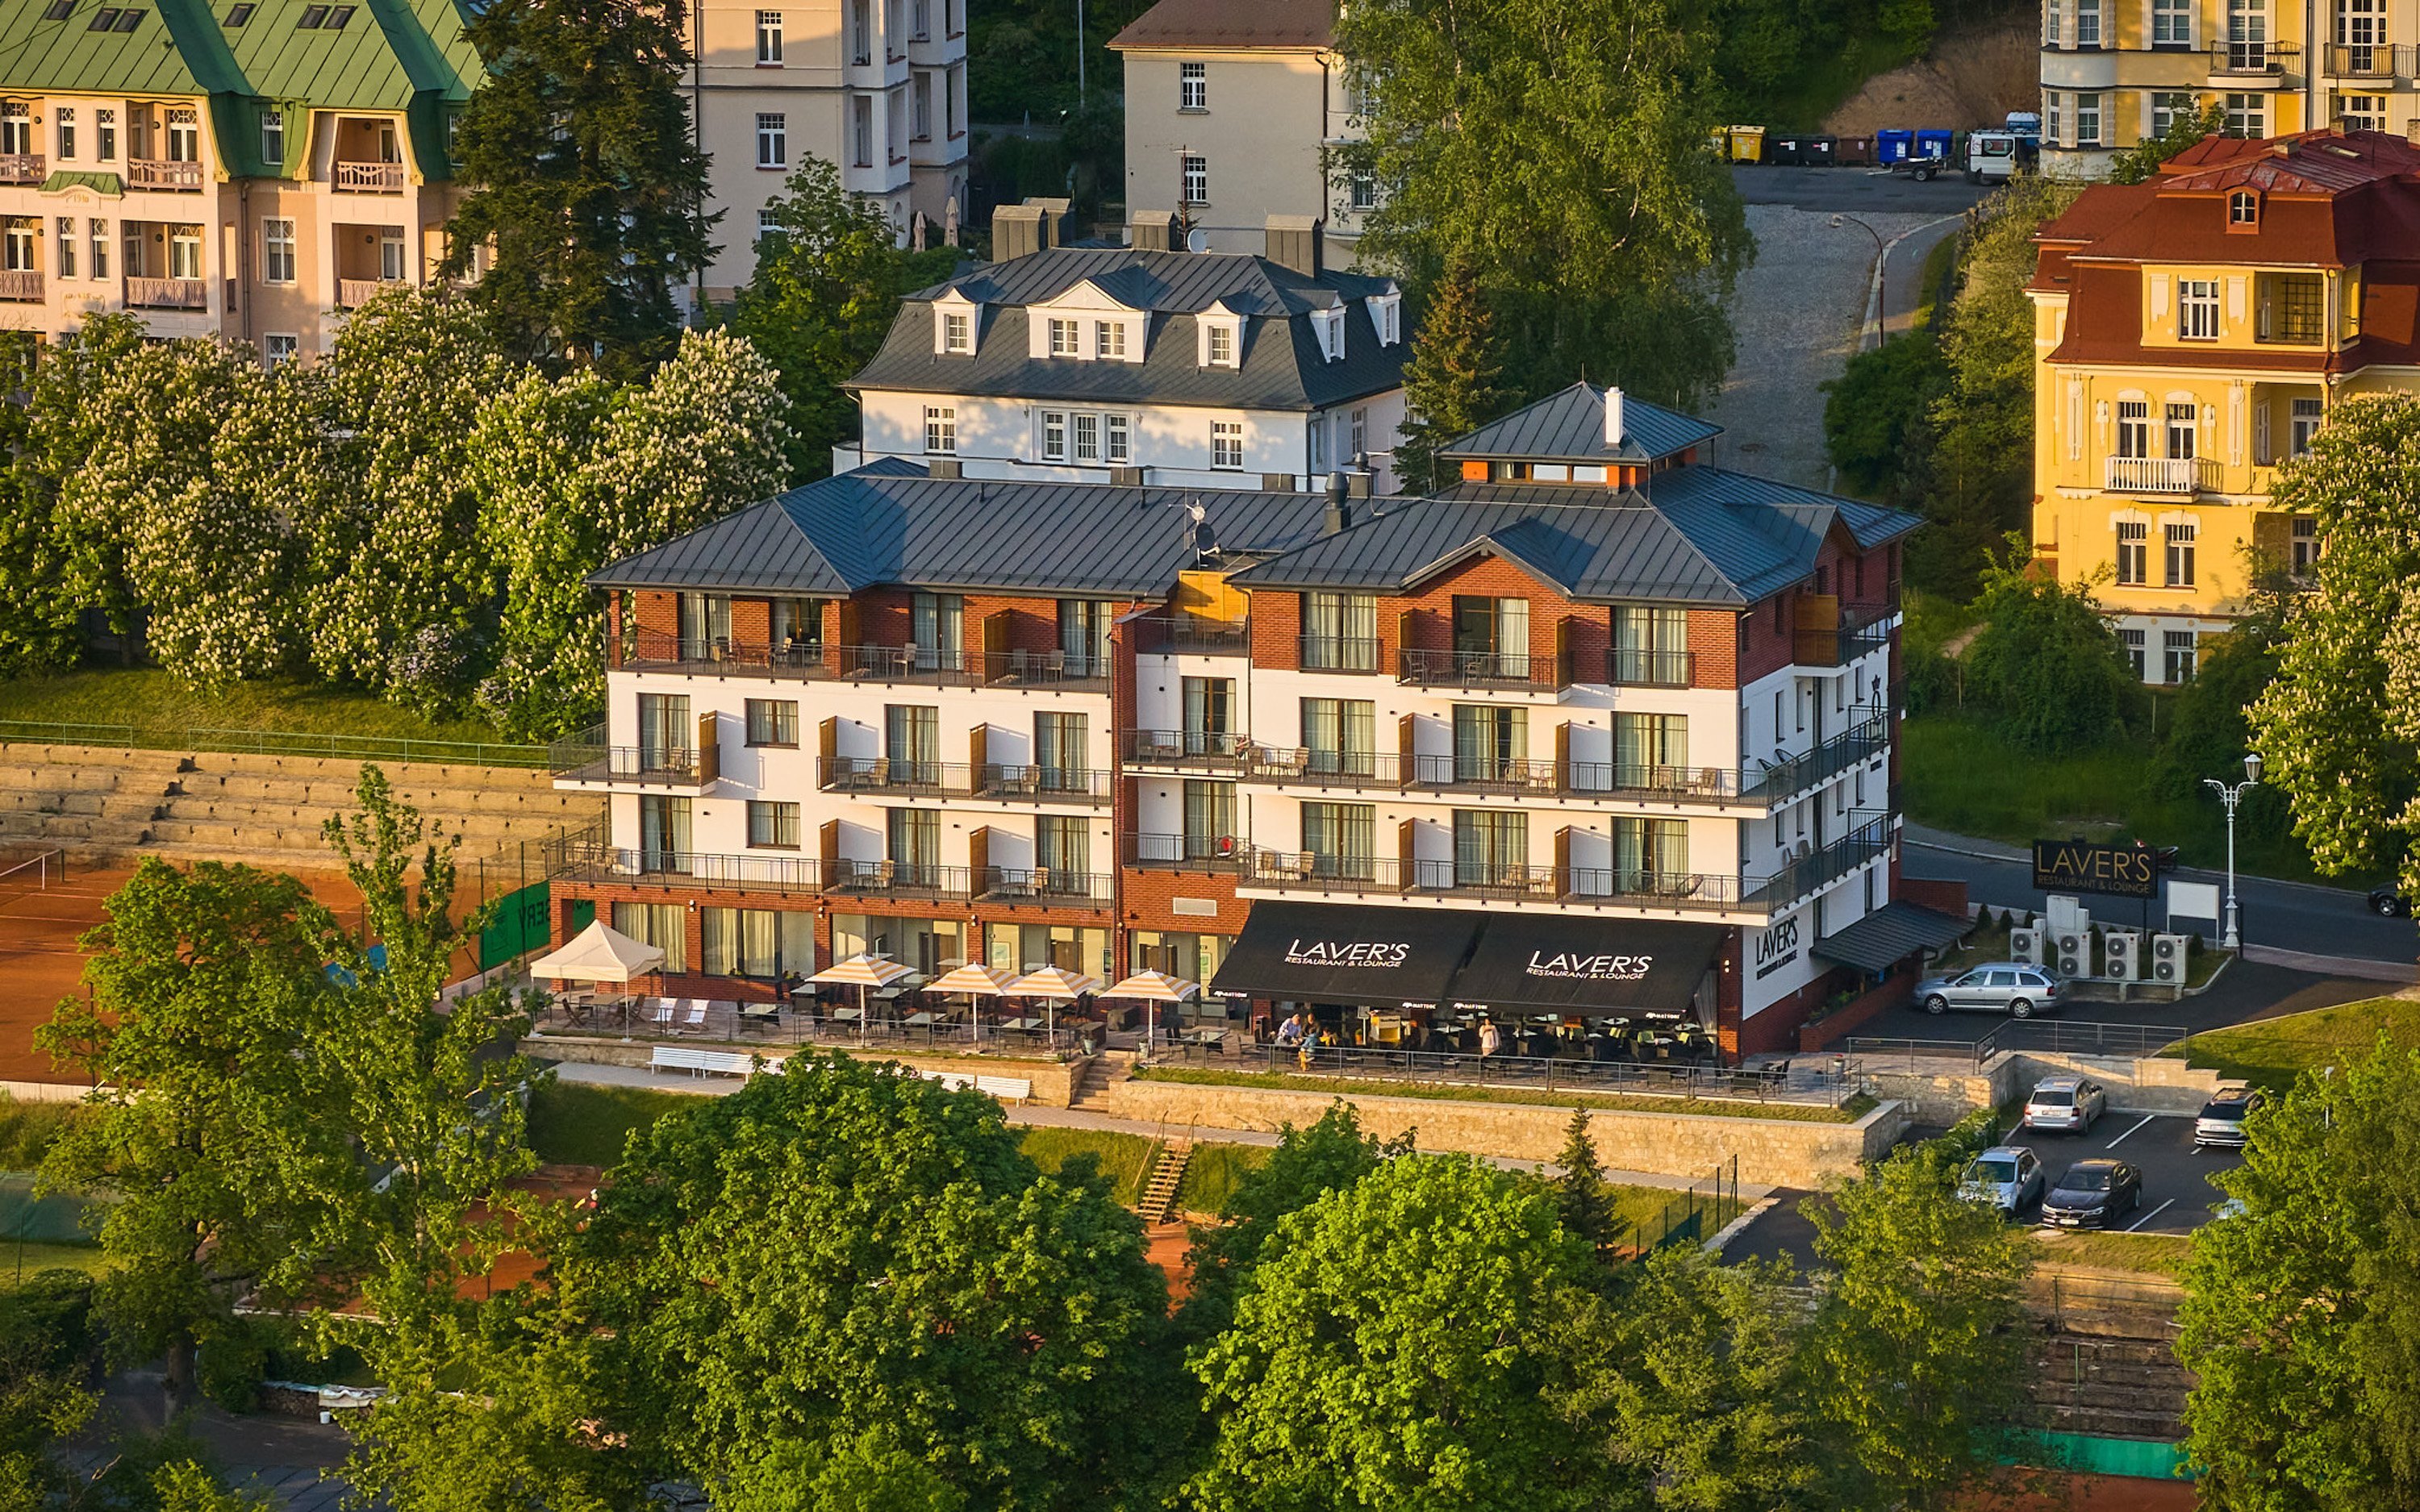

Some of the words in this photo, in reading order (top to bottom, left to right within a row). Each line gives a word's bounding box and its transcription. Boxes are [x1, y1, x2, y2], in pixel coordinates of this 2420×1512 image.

[2038, 846, 2151, 882] LAVER'S
[2038, 875, 2096, 889] RESTAURANT
[2100, 881, 2106, 889] &
[2109, 881, 2149, 894] LOUNGE
[1287, 938, 1410, 961] LAVER'S
[1756, 914, 1798, 966] LAVER'S
[1284, 956, 1347, 967] RESTAURANT
[1358, 960, 1402, 968] LOUNGE
[1525, 967, 1590, 979] RESTAURANT
[1529, 950, 1653, 973] LAVER'S
